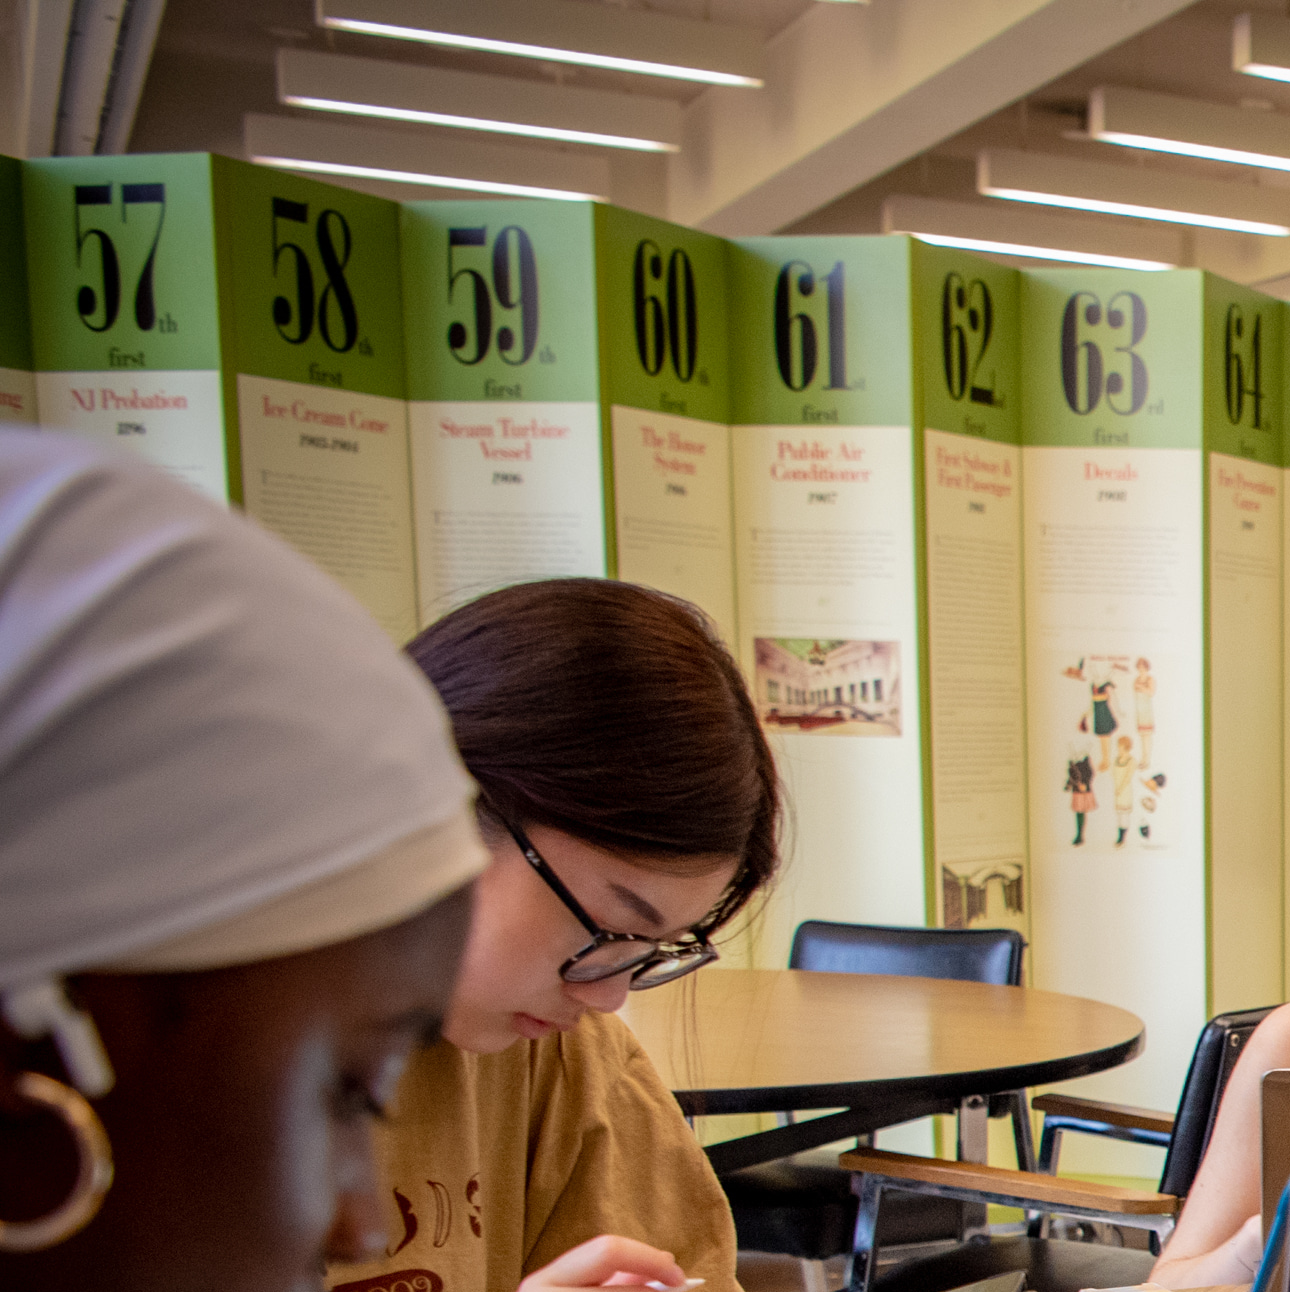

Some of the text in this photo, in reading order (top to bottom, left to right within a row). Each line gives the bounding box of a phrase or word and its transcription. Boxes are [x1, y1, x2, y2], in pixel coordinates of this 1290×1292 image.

[109, 347, 146, 367] first
[308, 361, 343, 386] first
[484, 378, 522, 398] first
[70, 388, 188, 412] NJ Probation
[262, 394, 390, 434] Ice Cream Cone
[802, 403, 839, 421] first
[439, 417, 571, 439] Steam Turbine
[1093, 427, 1129, 444] first
[479, 440, 533, 460] Vessel
[777, 440, 866, 461] Public Air
[769, 462, 872, 482] Conditioner
[1084, 461, 1138, 481] Decals
